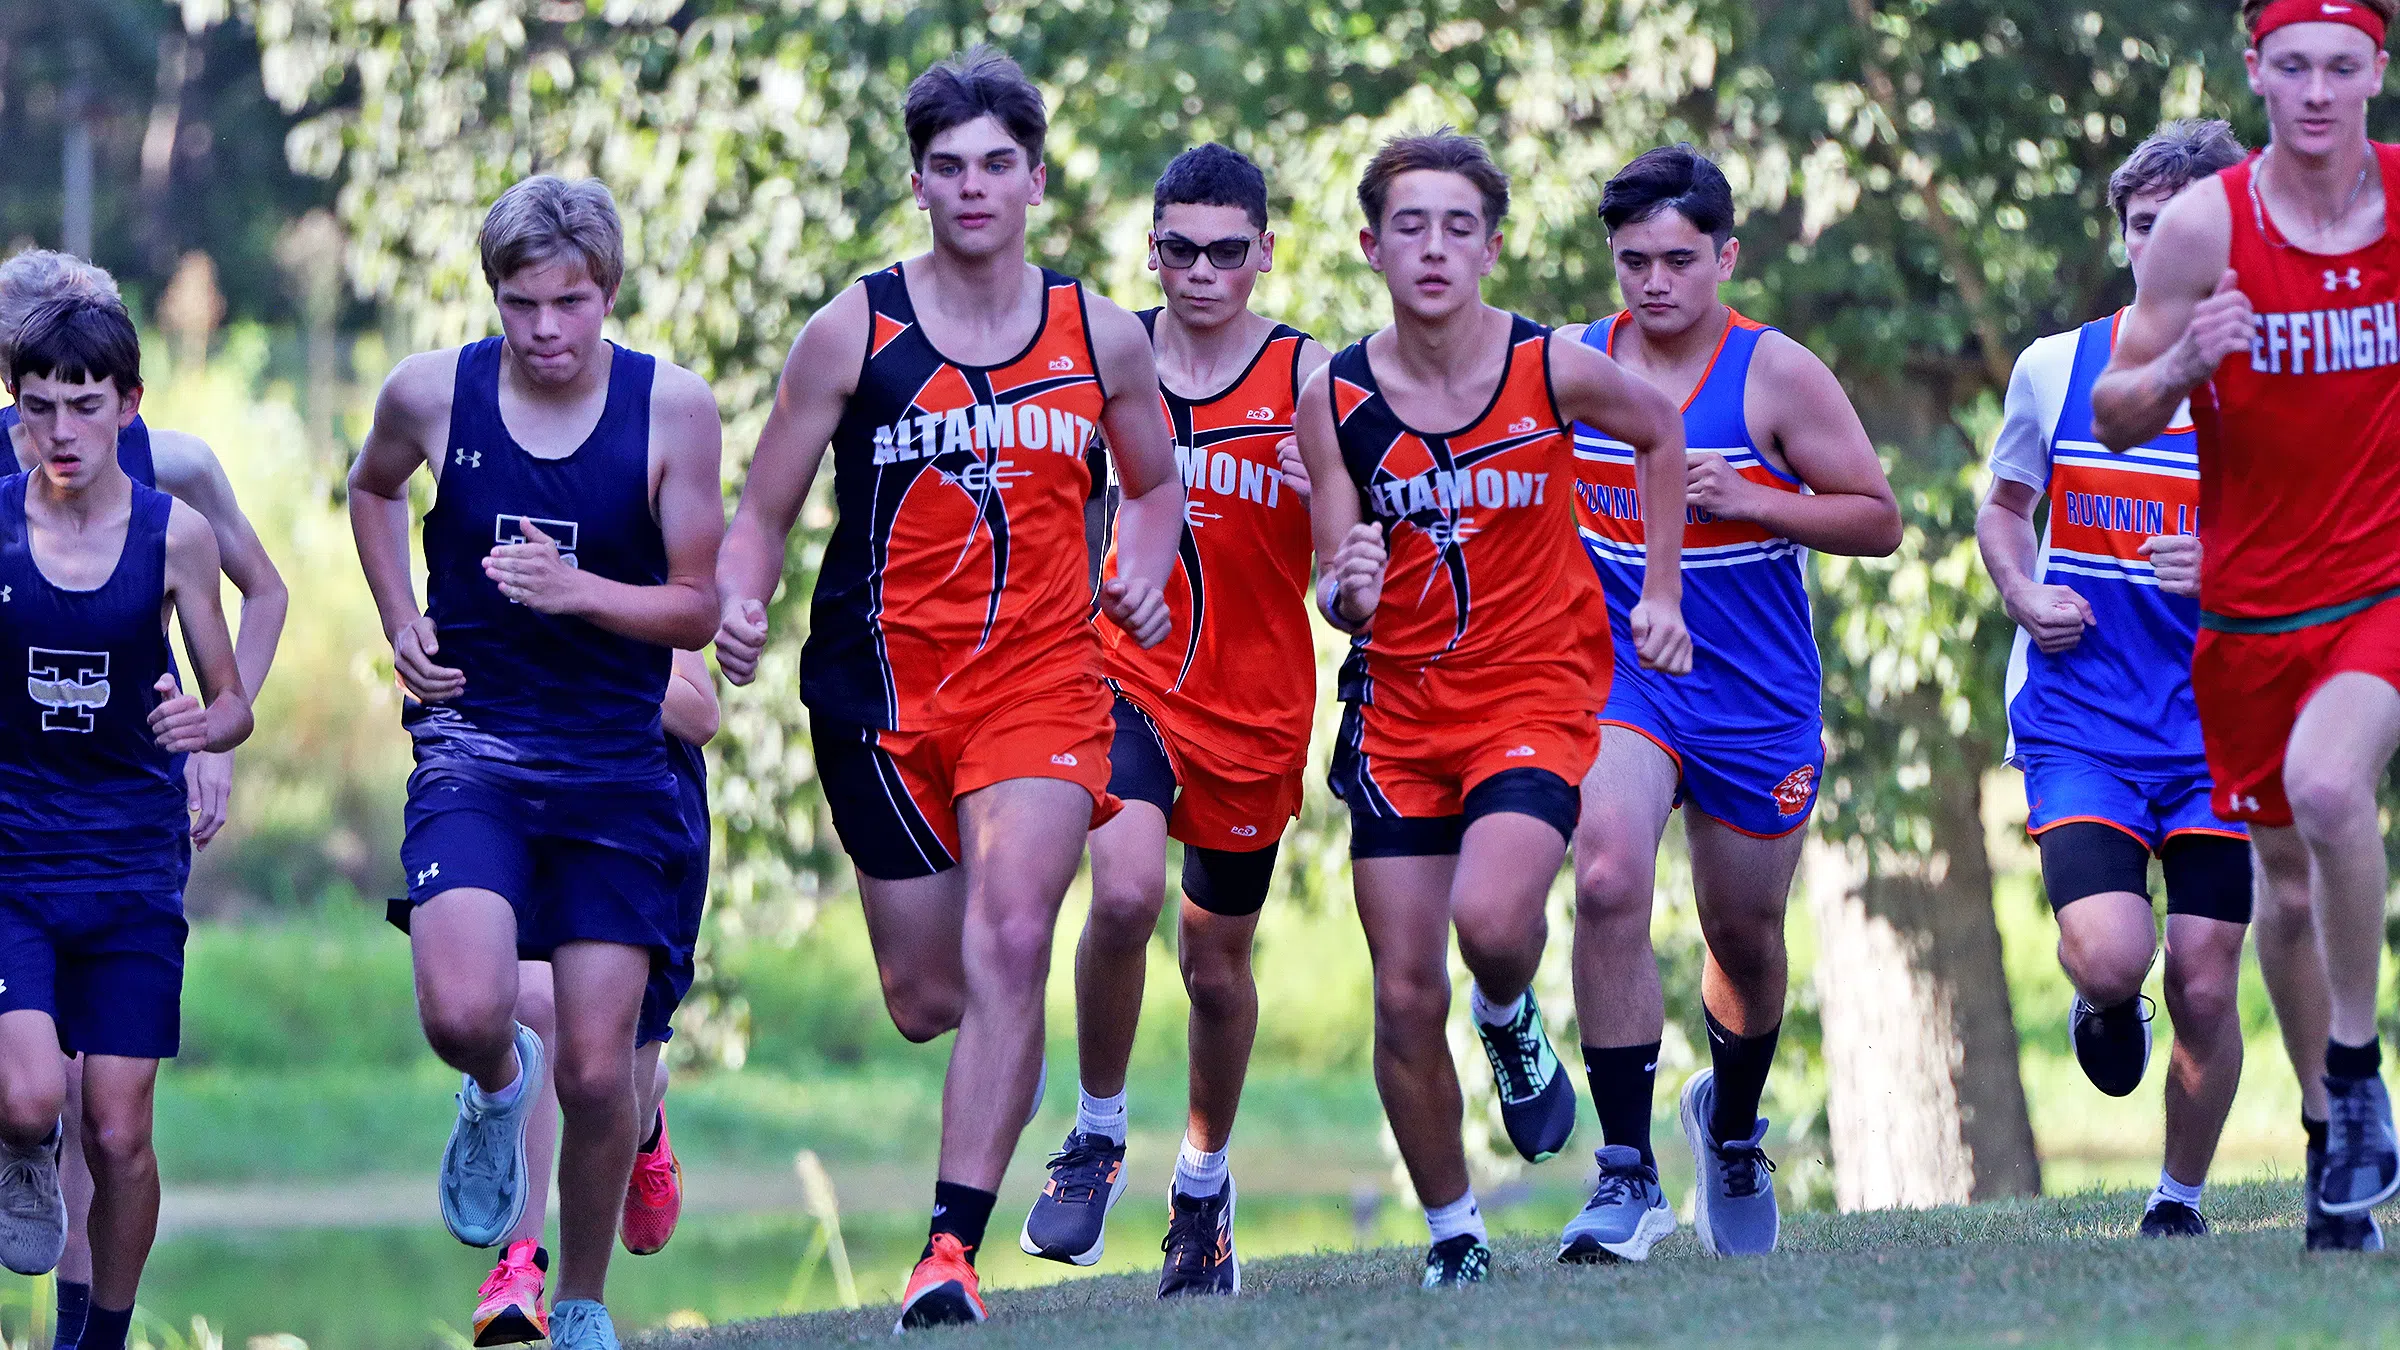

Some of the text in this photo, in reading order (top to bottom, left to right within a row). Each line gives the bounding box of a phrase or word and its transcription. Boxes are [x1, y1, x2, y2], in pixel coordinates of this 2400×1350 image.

[872, 404, 1093, 466] ALTAMONT
[1246, 408, 1273, 421] PCS
[1107, 445, 1283, 509] MONT
[1363, 468, 1549, 518] LTAMONT
[1575, 478, 1644, 522] RUNNI
[2065, 491, 2164, 536] RUNNIN
